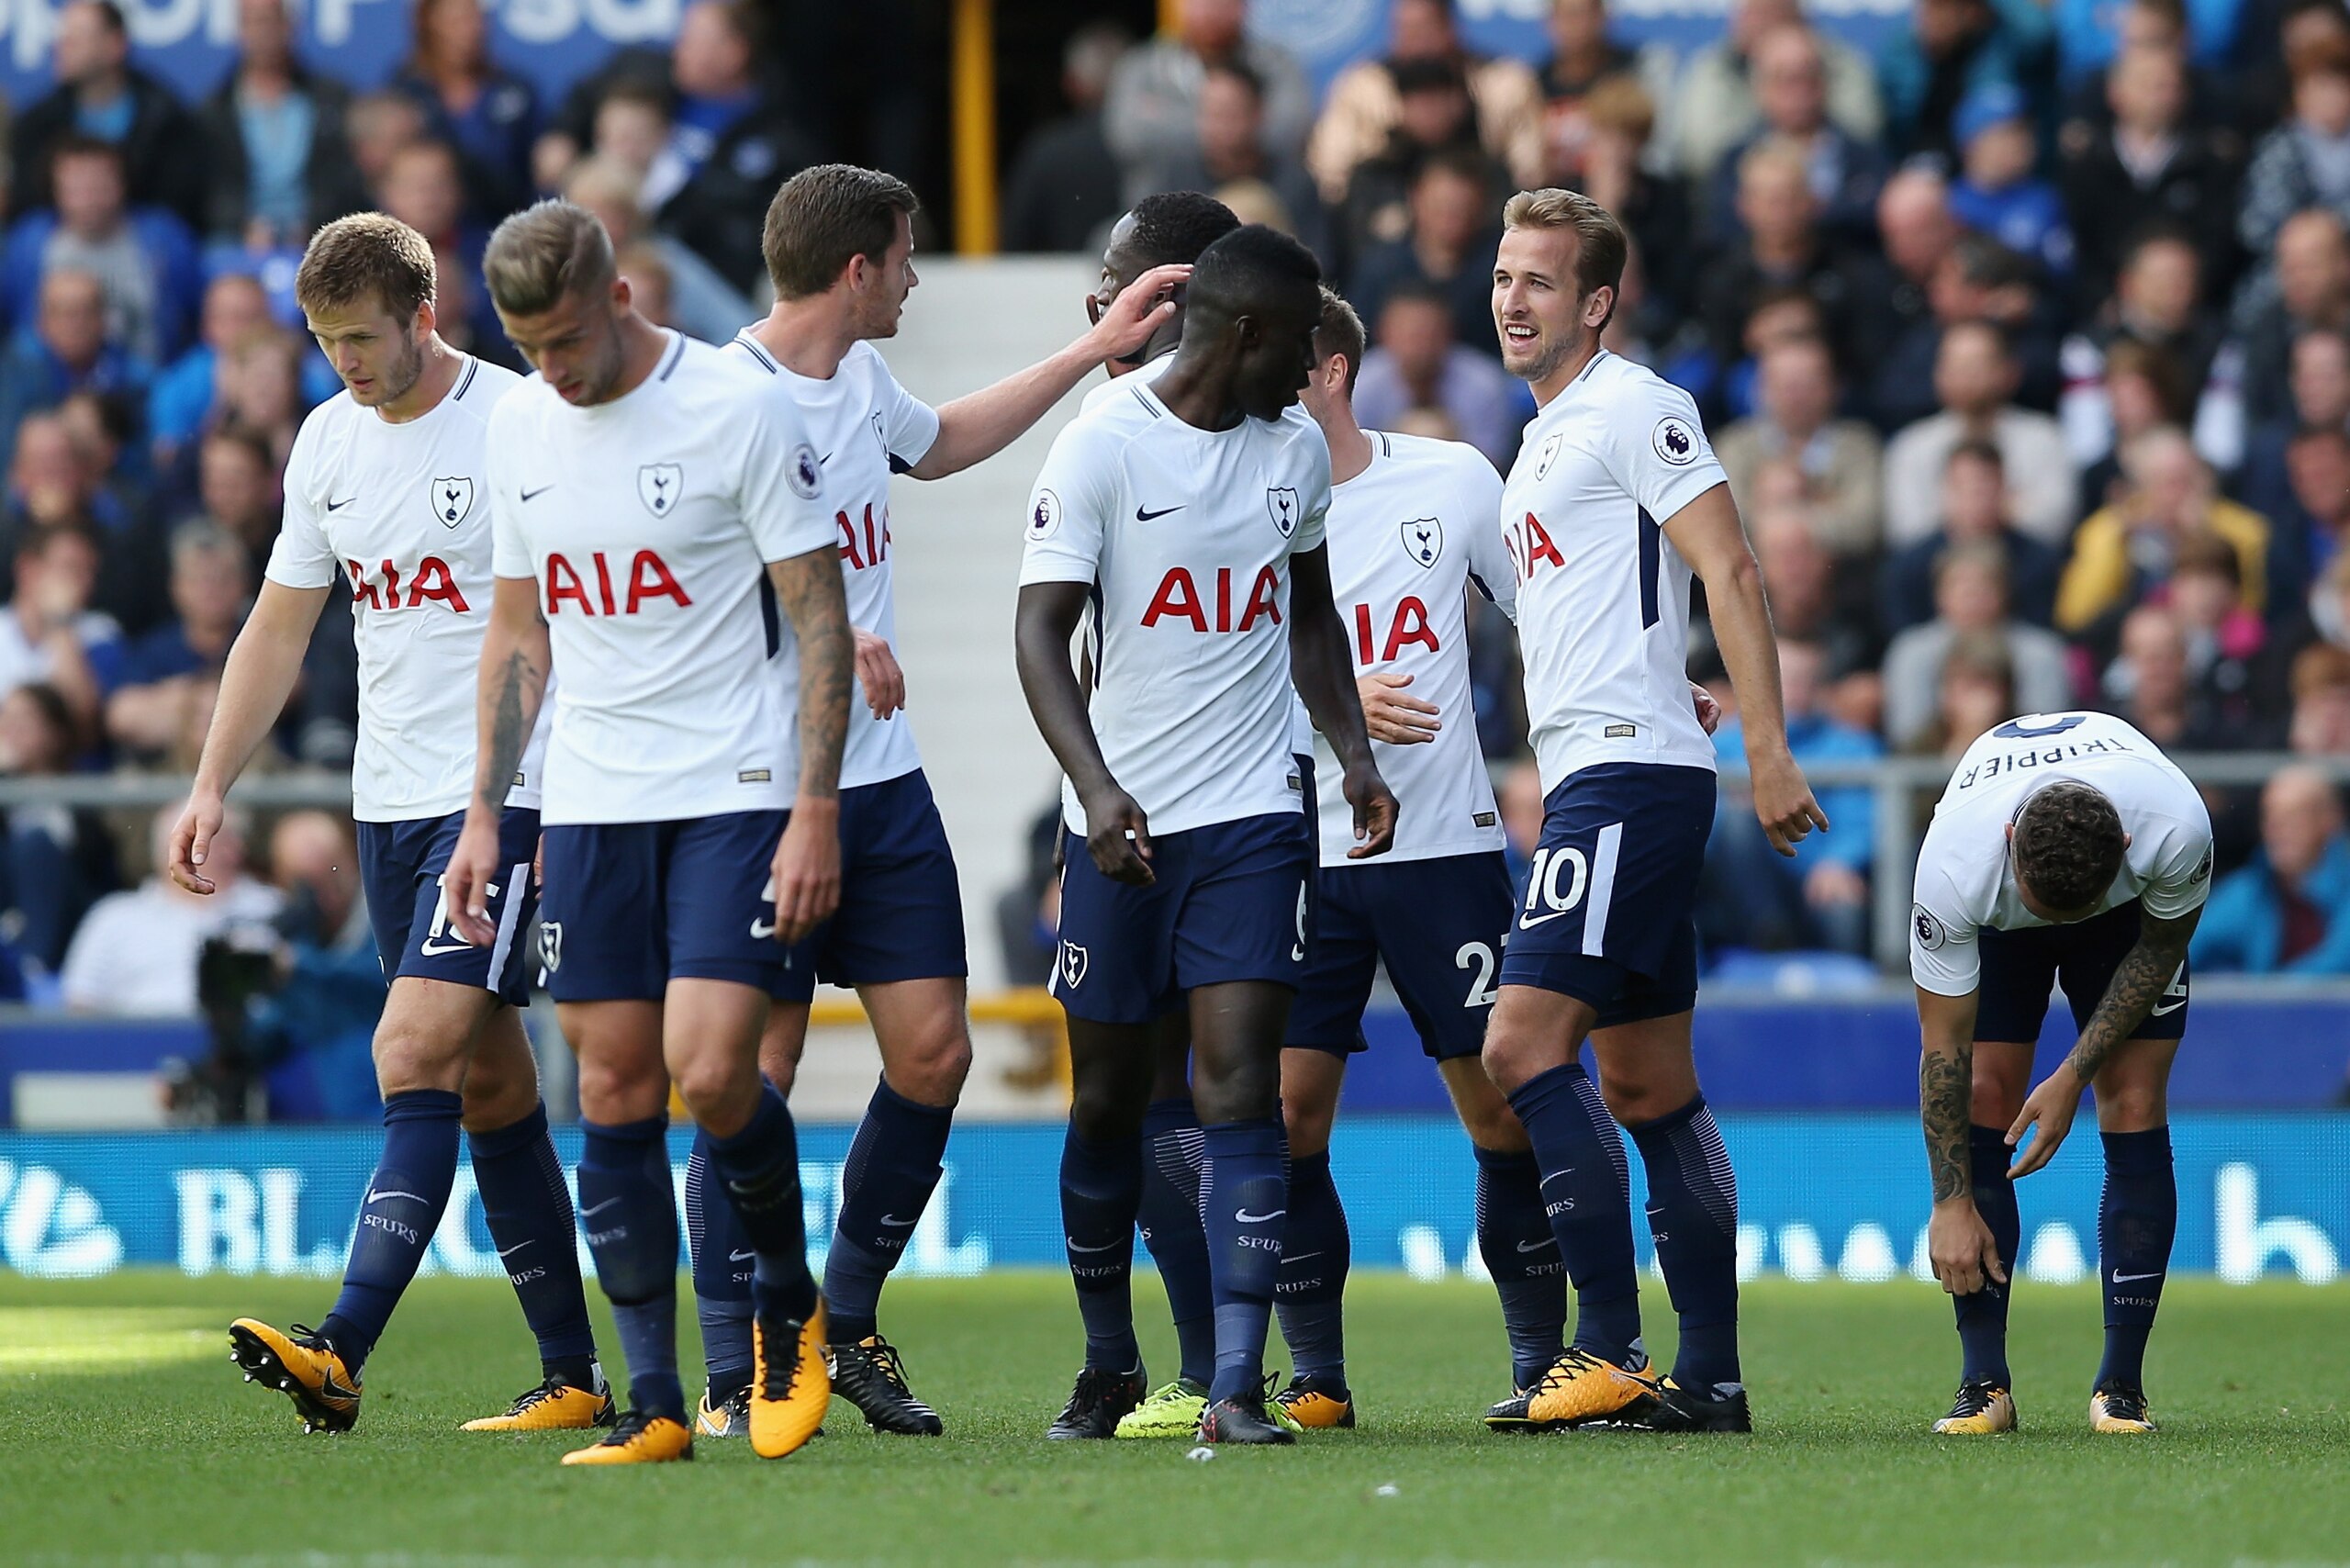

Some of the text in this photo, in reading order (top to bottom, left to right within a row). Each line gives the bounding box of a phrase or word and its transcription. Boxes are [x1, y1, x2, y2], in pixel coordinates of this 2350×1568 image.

[348, 556, 471, 612] AIA
[547, 549, 693, 616] AIA
[1140, 565, 1282, 633] AIA
[1355, 596, 1440, 666] IA
[1959, 737, 2133, 790] TRIPPIER
[1526, 847, 1587, 912] 10
[1456, 933, 1511, 1008] 2
[1544, 1197, 1575, 1218] URS
[364, 1214, 419, 1245] SPURS
[1237, 1235, 1282, 1258] SPUR
[510, 1266, 546, 1285] URS
[1276, 1277, 1322, 1294] PURS
[1526, 1261, 1564, 1276] SPU
[2113, 1295, 2154, 1307] SPURS
